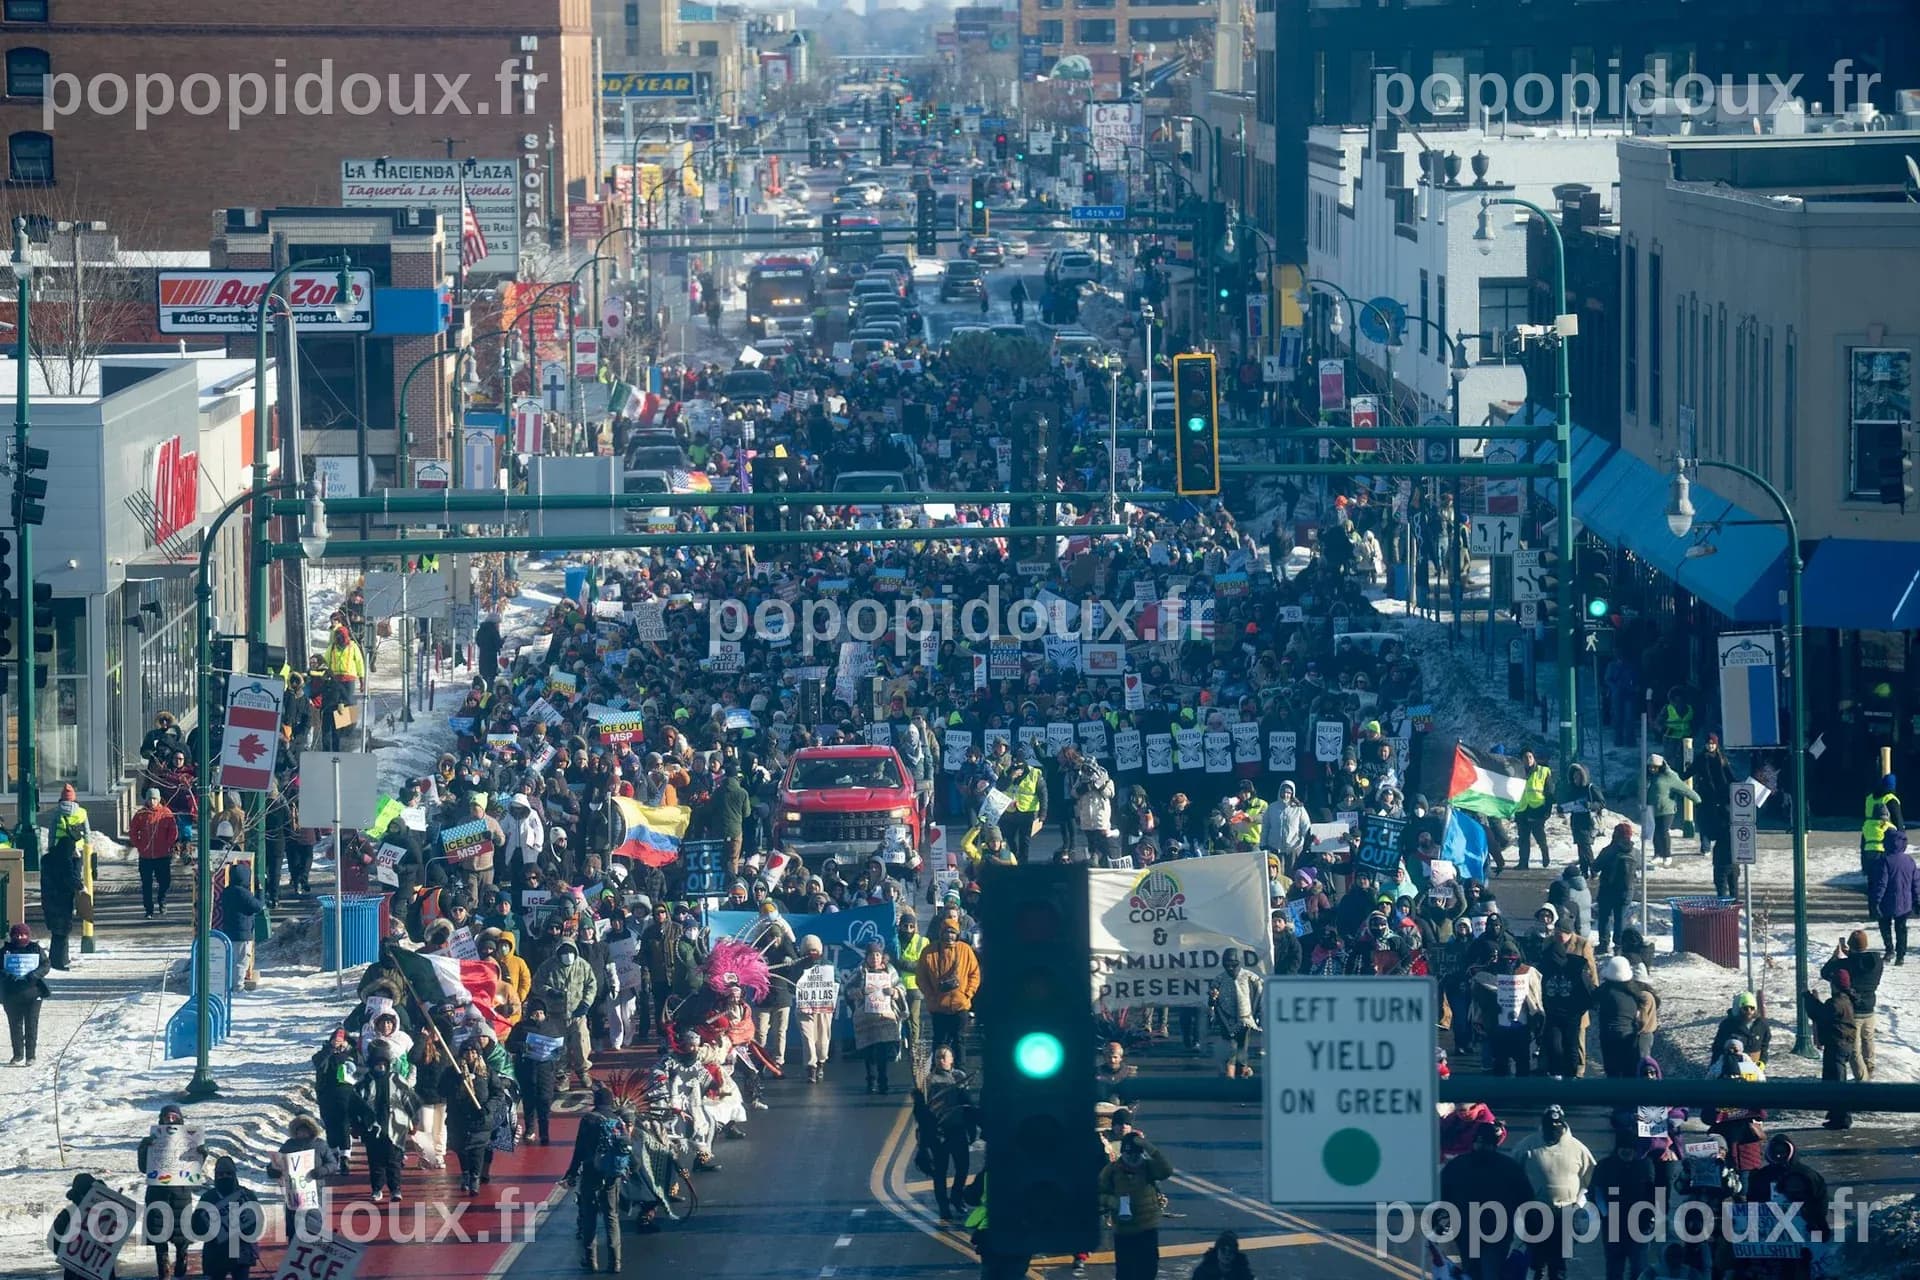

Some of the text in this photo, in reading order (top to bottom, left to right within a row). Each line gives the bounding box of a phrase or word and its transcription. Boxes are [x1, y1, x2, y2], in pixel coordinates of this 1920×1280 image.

[520, 35, 538, 112] MINI
[1095, 108, 1108, 123] C
[345, 162, 366, 179] LA
[372, 160, 455, 179] HACIENDA
[347, 183, 513, 198] Taqueria La Hacienda
[1086, 209, 1104, 217] 4th
[1109, 209, 1121, 217] Av
[179, 313, 206, 323] Auto
[208, 313, 240, 323] Parts
[1472, 545, 1492, 553] ONLY
[600, 722, 641, 733] ICE OUT
[1049, 727, 1073, 735] DEFEND
[1080, 725, 1103, 733] DEFEND
[1234, 726, 1258, 735] DEFEND
[1318, 725, 1342, 733] DEFEND
[610, 732, 633, 743] MSP
[946, 734, 970, 743] DEFEND
[1115, 735, 1139, 744] DEFEND
[1178, 732, 1201, 740] DEFEND
[1209, 736, 1229, 745] EFEND
[1271, 735, 1295, 743] DEFEND
[444, 833, 483, 851] ICE OU
[1364, 826, 1400, 850] ICE
[383, 848, 400, 859] ICE
[456, 844, 482, 860] MSP
[686, 851, 722, 871] ICE
[1111, 859, 1132, 869] WAR
[528, 896, 545, 905] ICE
[1129, 906, 1188, 924] COPAL
[1153, 927, 1168, 946] &
[1099, 977, 1215, 999] PRESENT
[798, 990, 834, 1001] NO A LAS
[1276, 997, 1423, 1023] LEFT TURN
[1306, 1039, 1396, 1071] YIELD
[1280, 1088, 1423, 1115] ON GREEN
[1687, 1143, 1719, 1153] WE ARE
[290, 1246, 344, 1280] ICE
